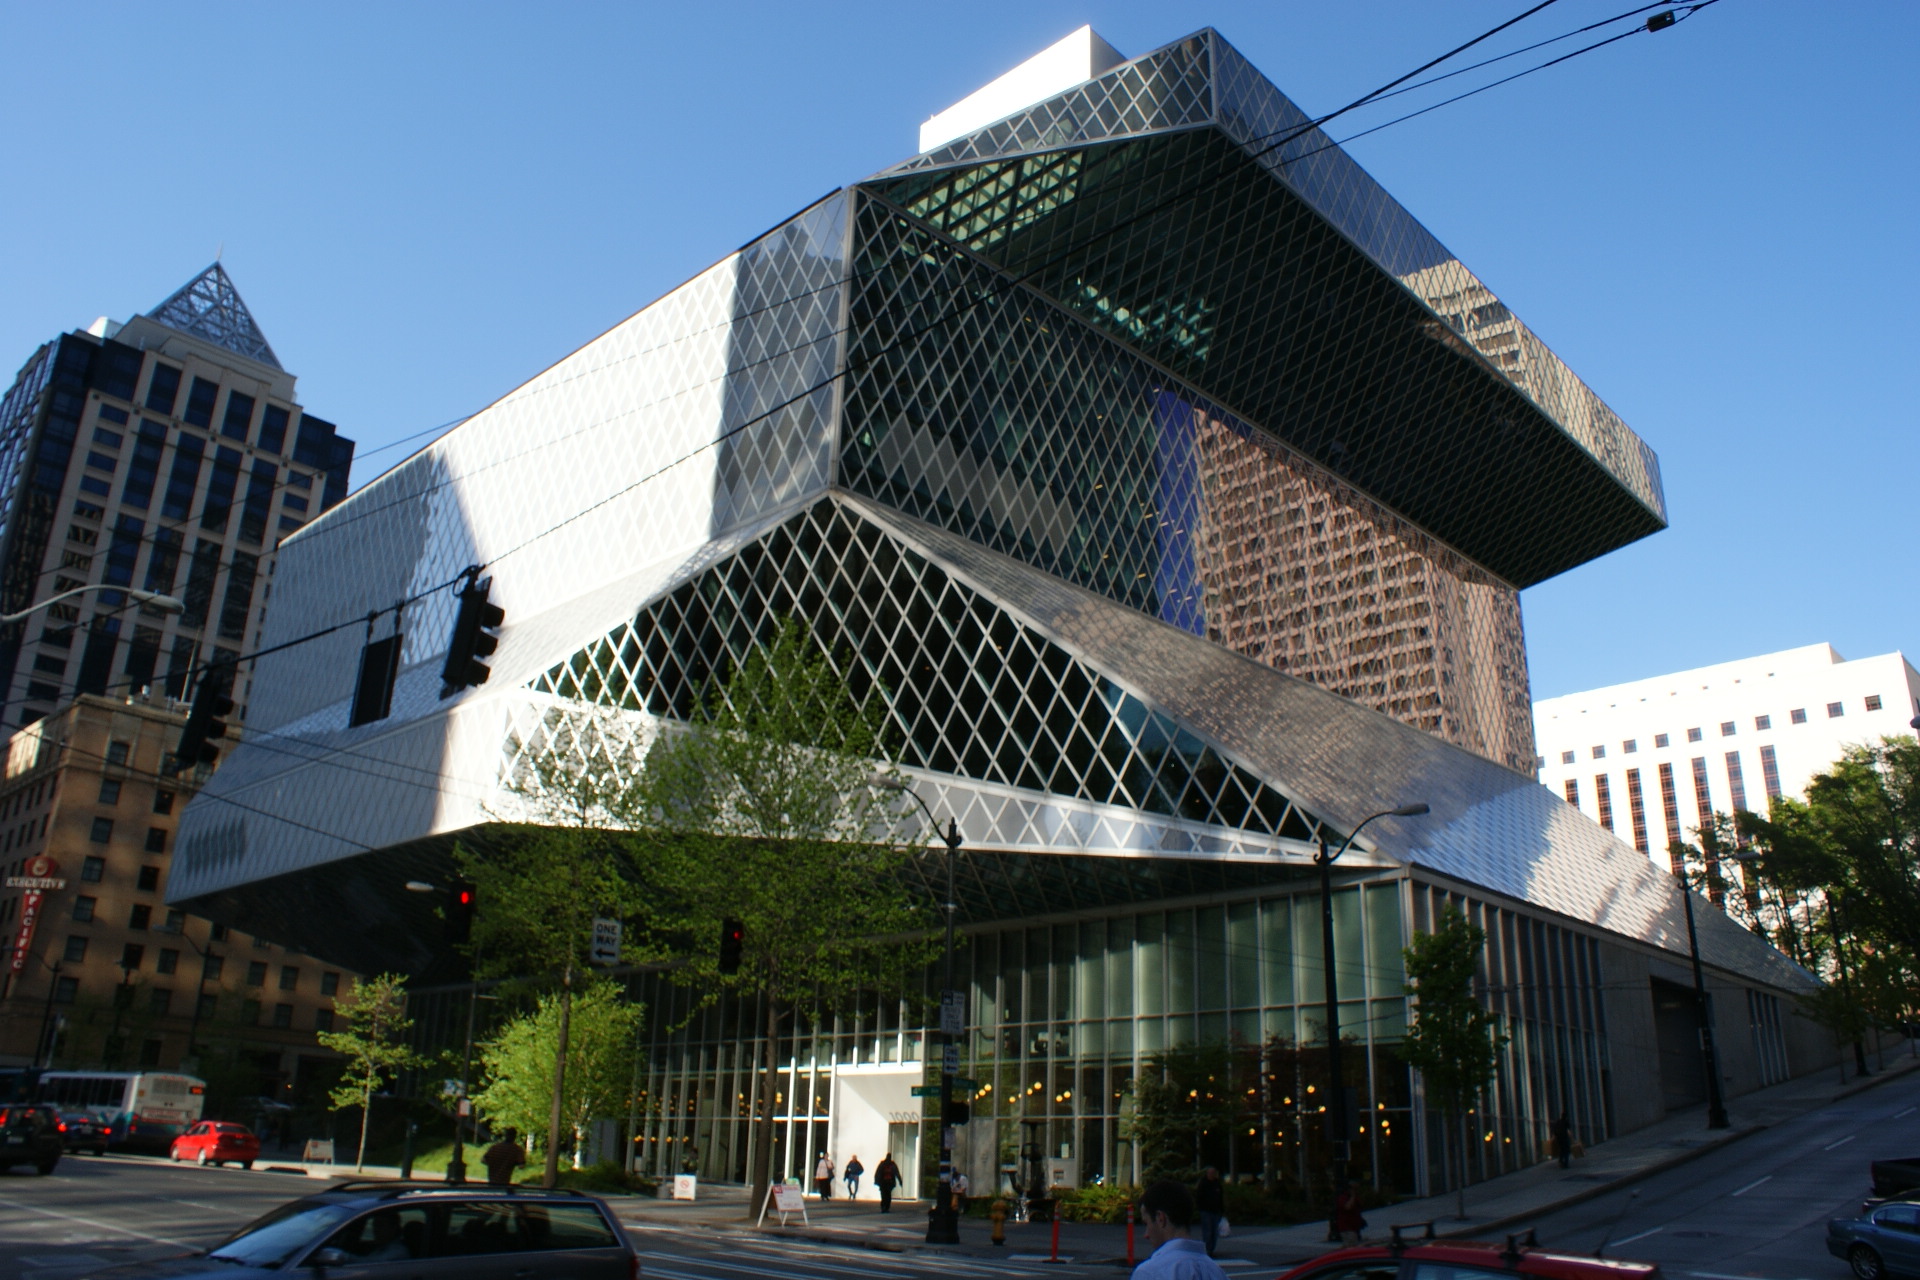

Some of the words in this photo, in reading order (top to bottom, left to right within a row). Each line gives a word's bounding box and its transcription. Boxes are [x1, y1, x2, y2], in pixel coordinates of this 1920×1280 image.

[13, 896, 38, 969] PACIFIC
[596, 923, 618, 935] ONE
[596, 935, 617, 946] WAY
[889, 1111, 920, 1122] 1000
